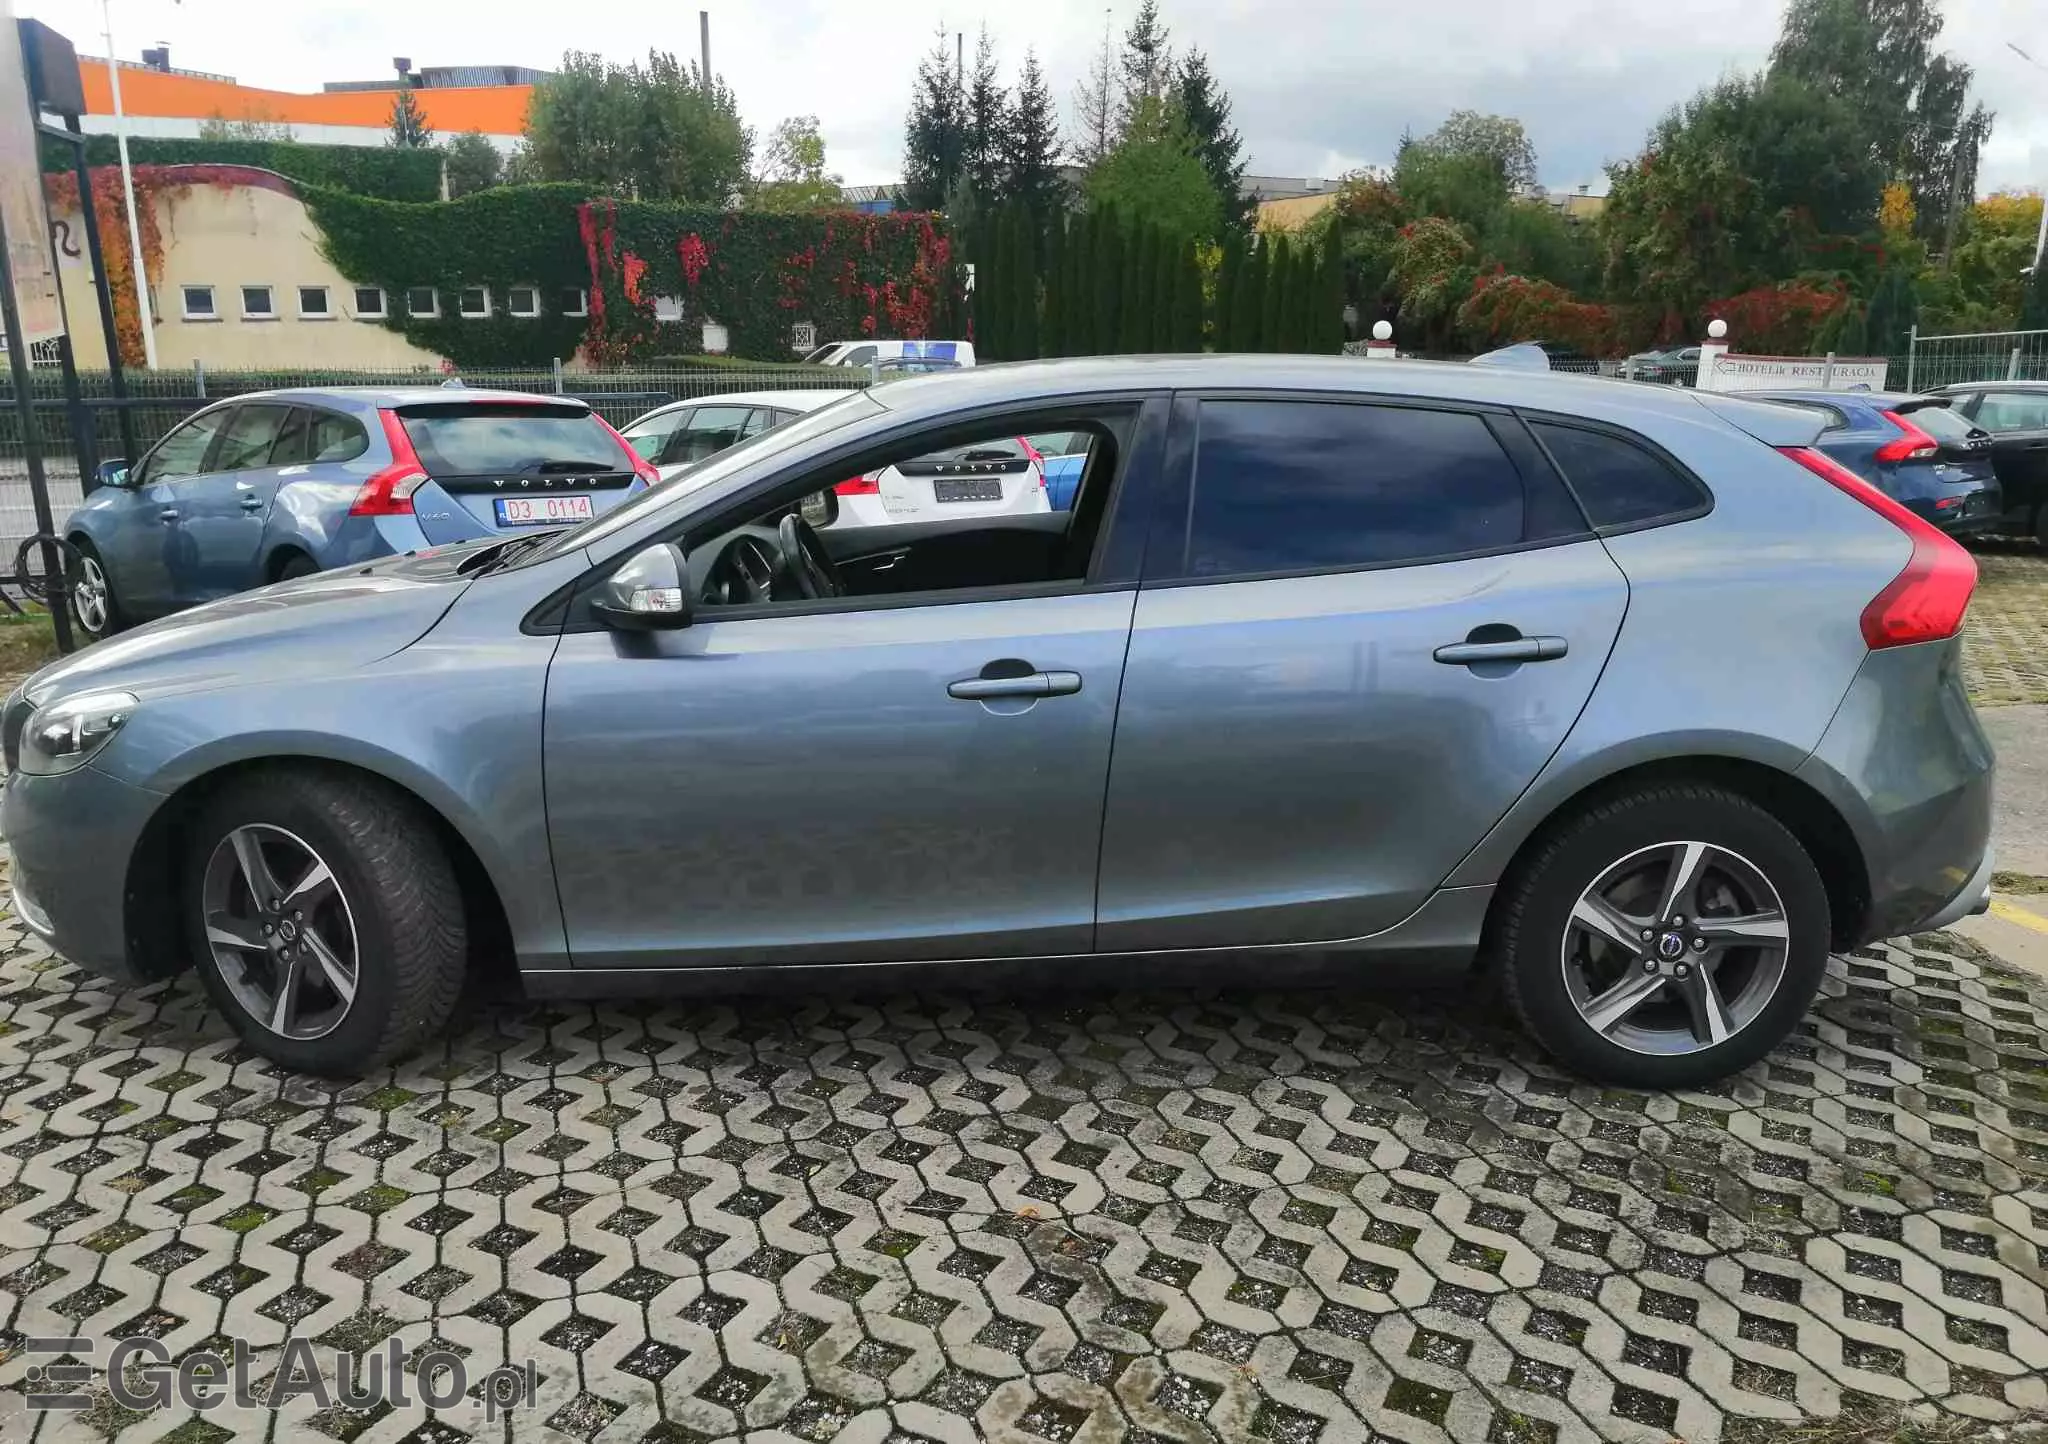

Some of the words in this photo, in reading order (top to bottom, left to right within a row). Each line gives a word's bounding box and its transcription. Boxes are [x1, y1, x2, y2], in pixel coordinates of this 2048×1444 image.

[493, 479, 598, 488] VOLVO
[508, 502, 532, 519] D3
[547, 499, 589, 517] 0114
